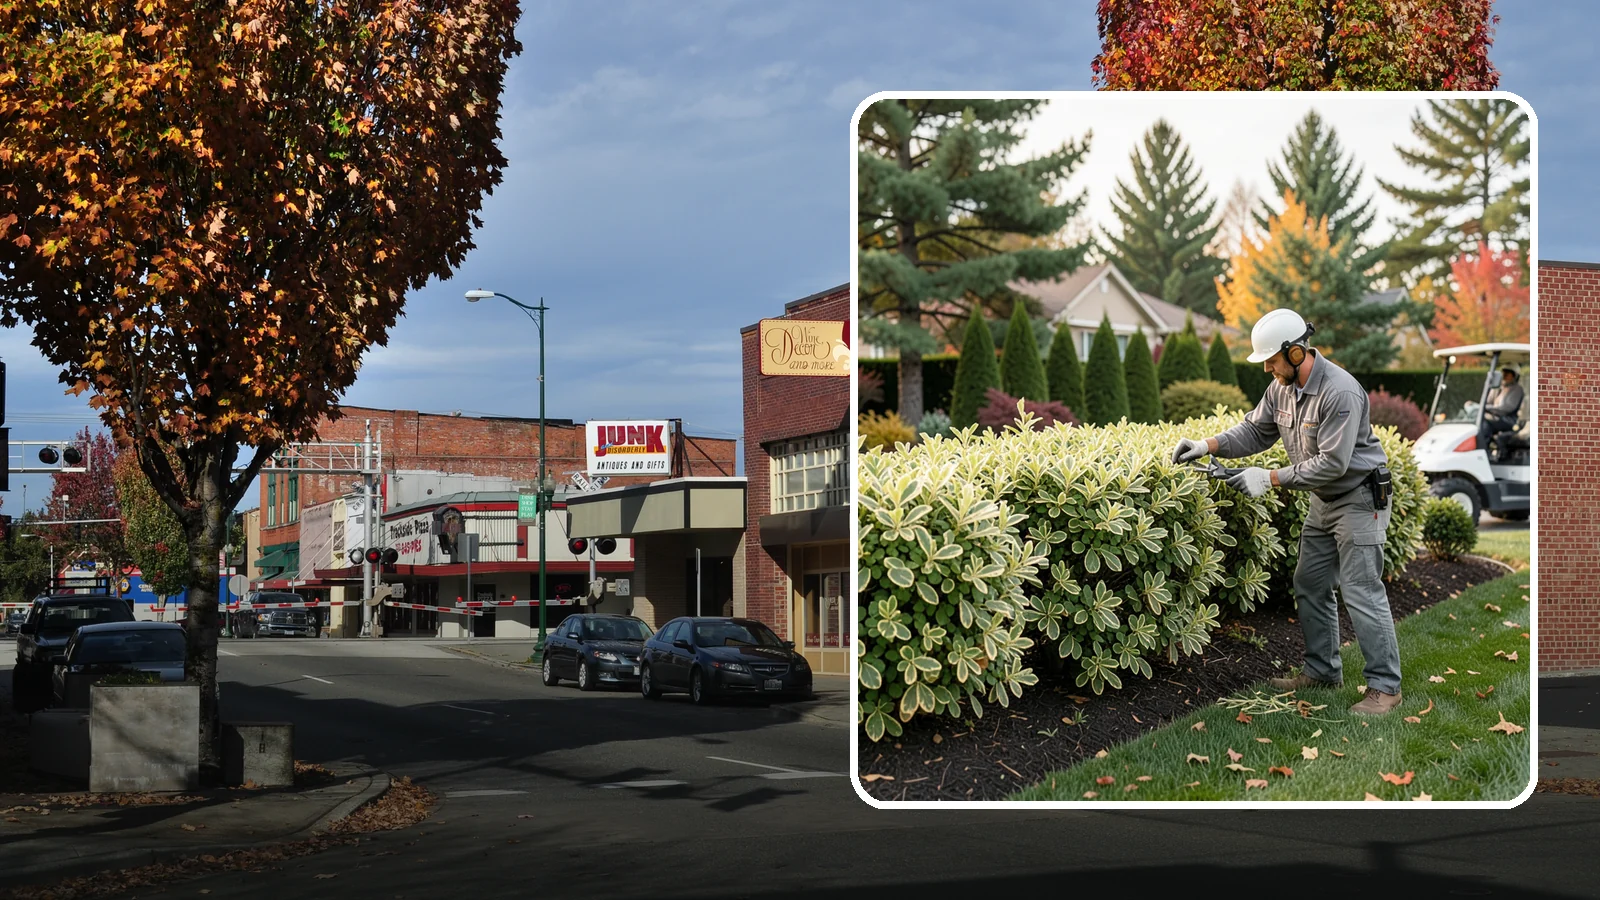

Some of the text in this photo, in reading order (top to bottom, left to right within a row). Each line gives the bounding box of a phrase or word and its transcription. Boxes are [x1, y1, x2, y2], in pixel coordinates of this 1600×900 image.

[596, 425, 665, 457] JUNK
[607, 446, 646, 454] DISORDERLY
[597, 460, 665, 470] ANTIQUES AND GIFTS
[573, 473, 589, 492] RAIL
[390, 521, 413, 540] Trackside
[414, 520, 429, 535] Pizza
